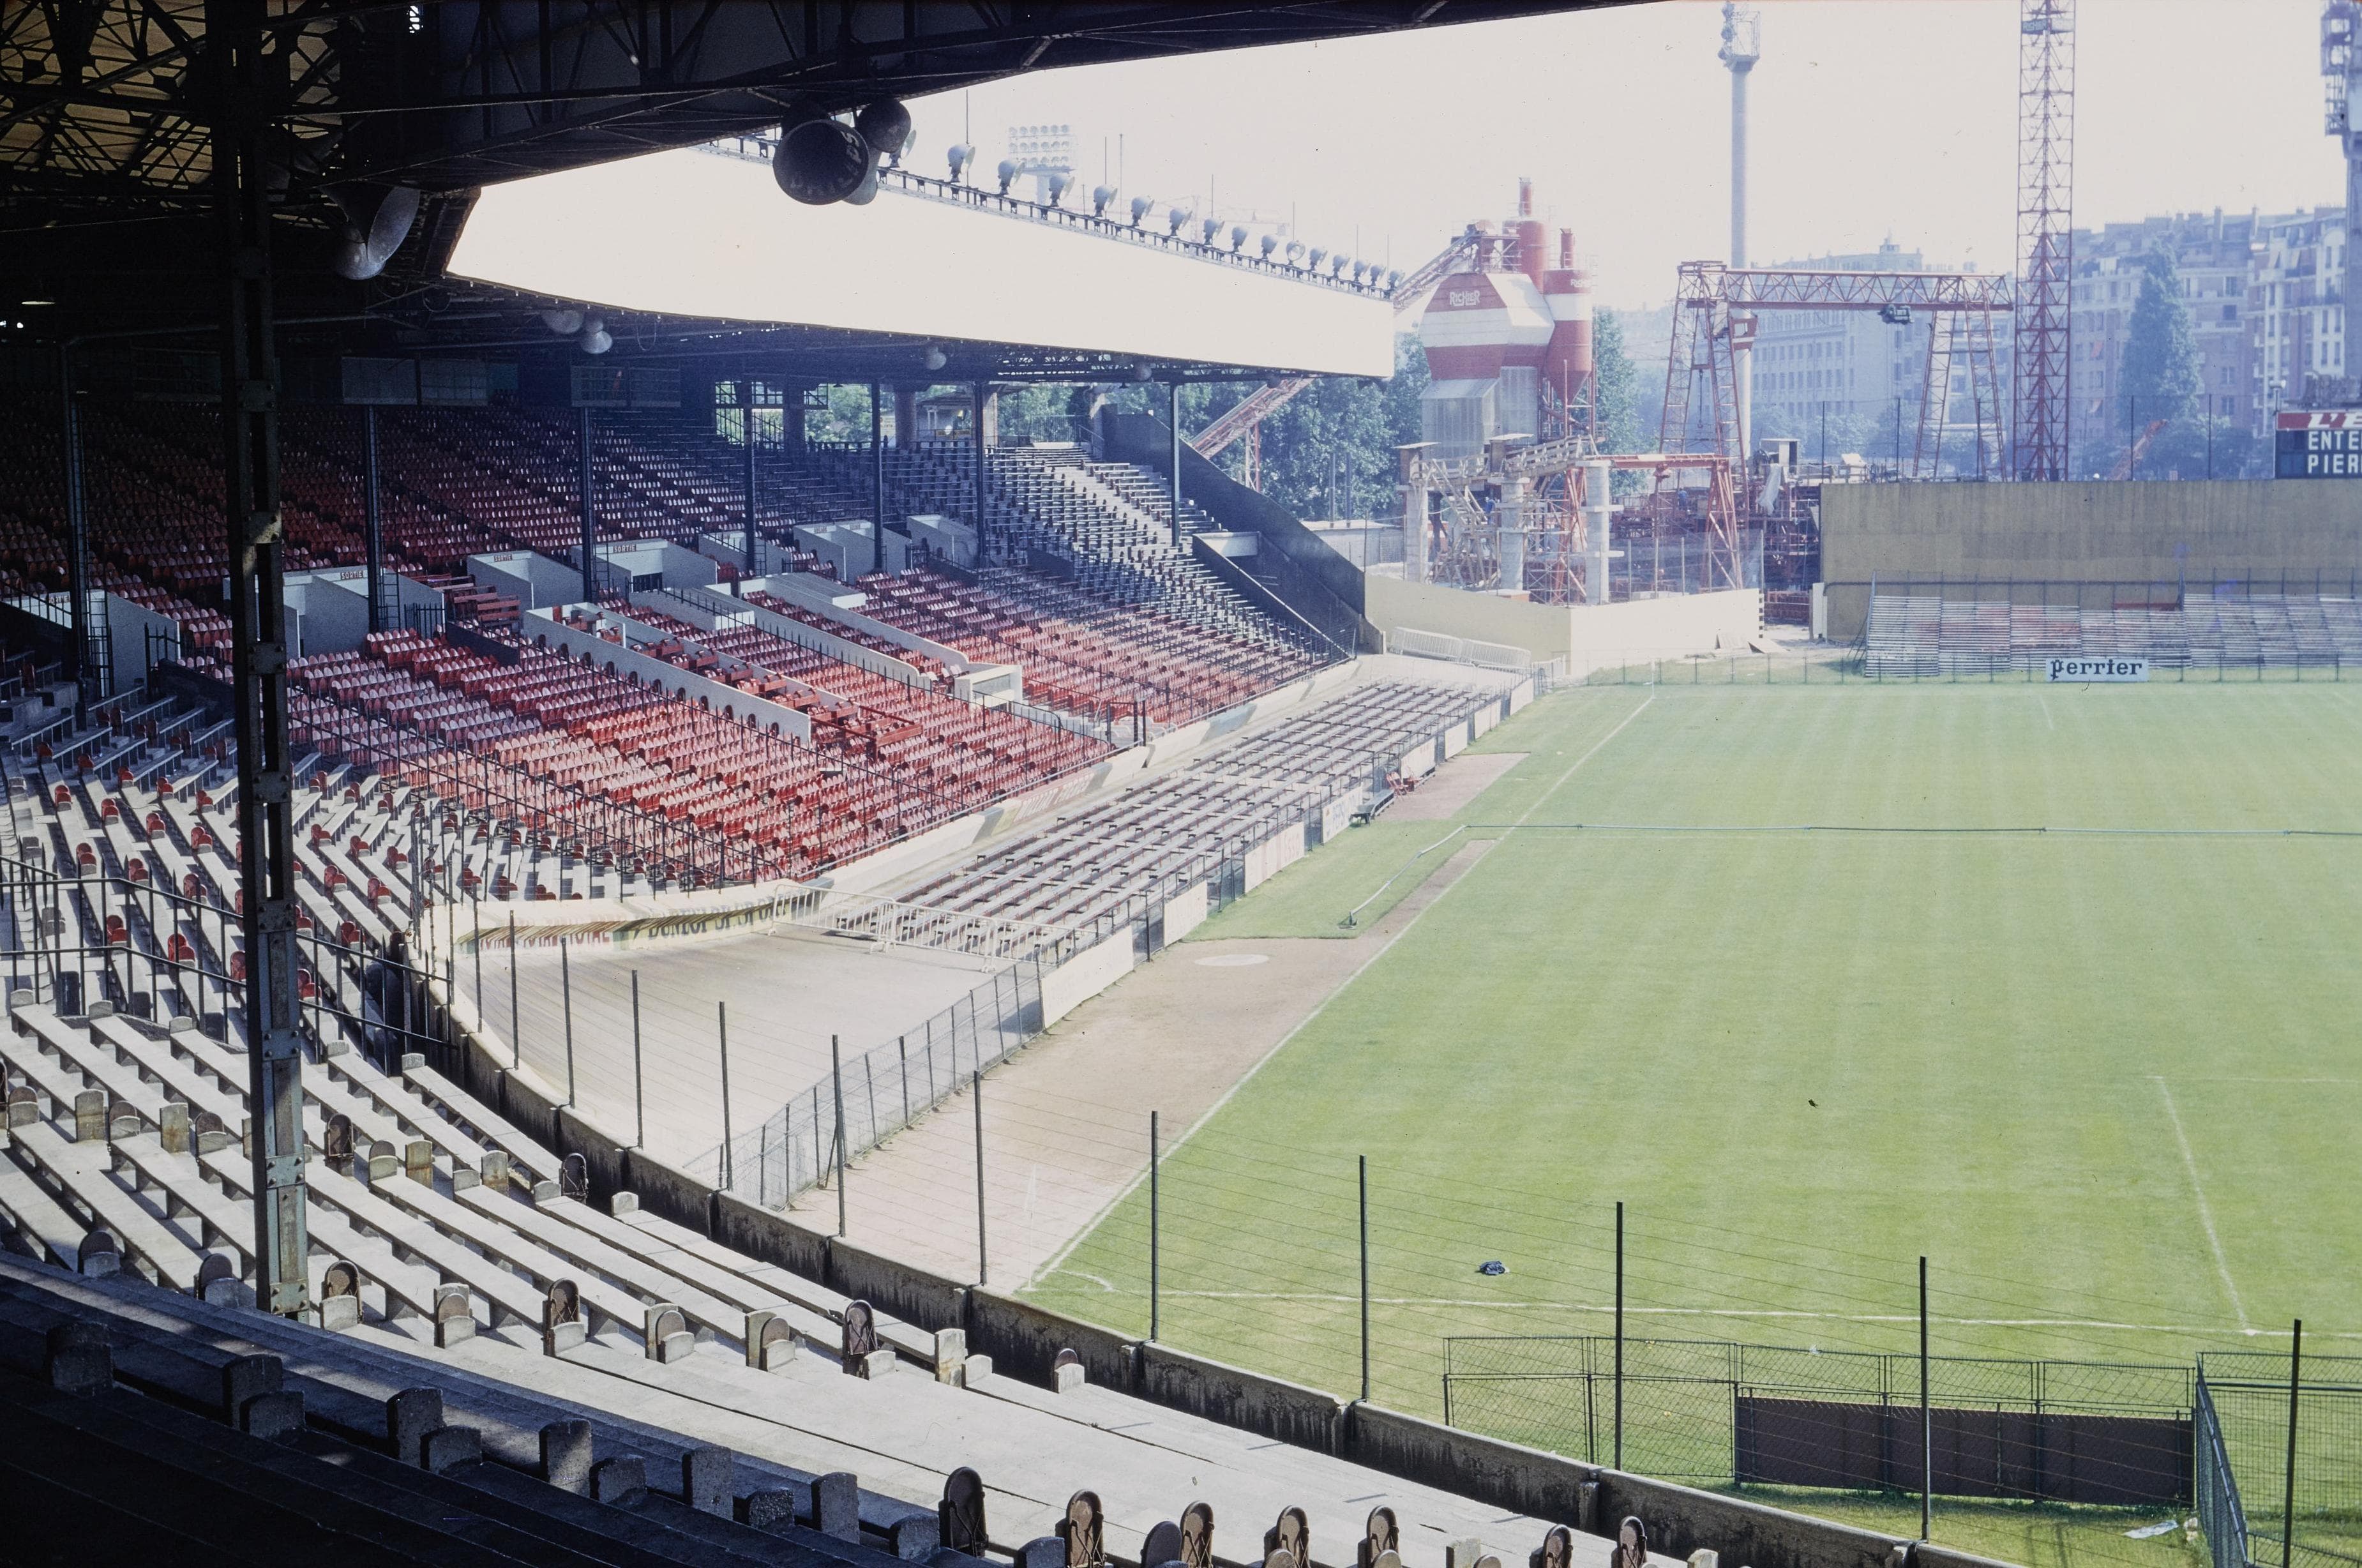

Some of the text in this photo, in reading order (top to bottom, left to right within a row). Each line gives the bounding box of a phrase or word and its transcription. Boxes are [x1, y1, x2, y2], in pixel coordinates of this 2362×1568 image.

[1450, 290, 1480, 306] RICHIER
[2308, 430, 2362, 451] ENTE
[2308, 453, 2362, 474] PIER
[614, 545, 635, 553] SORTIE
[341, 571, 363, 580] SORTIE
